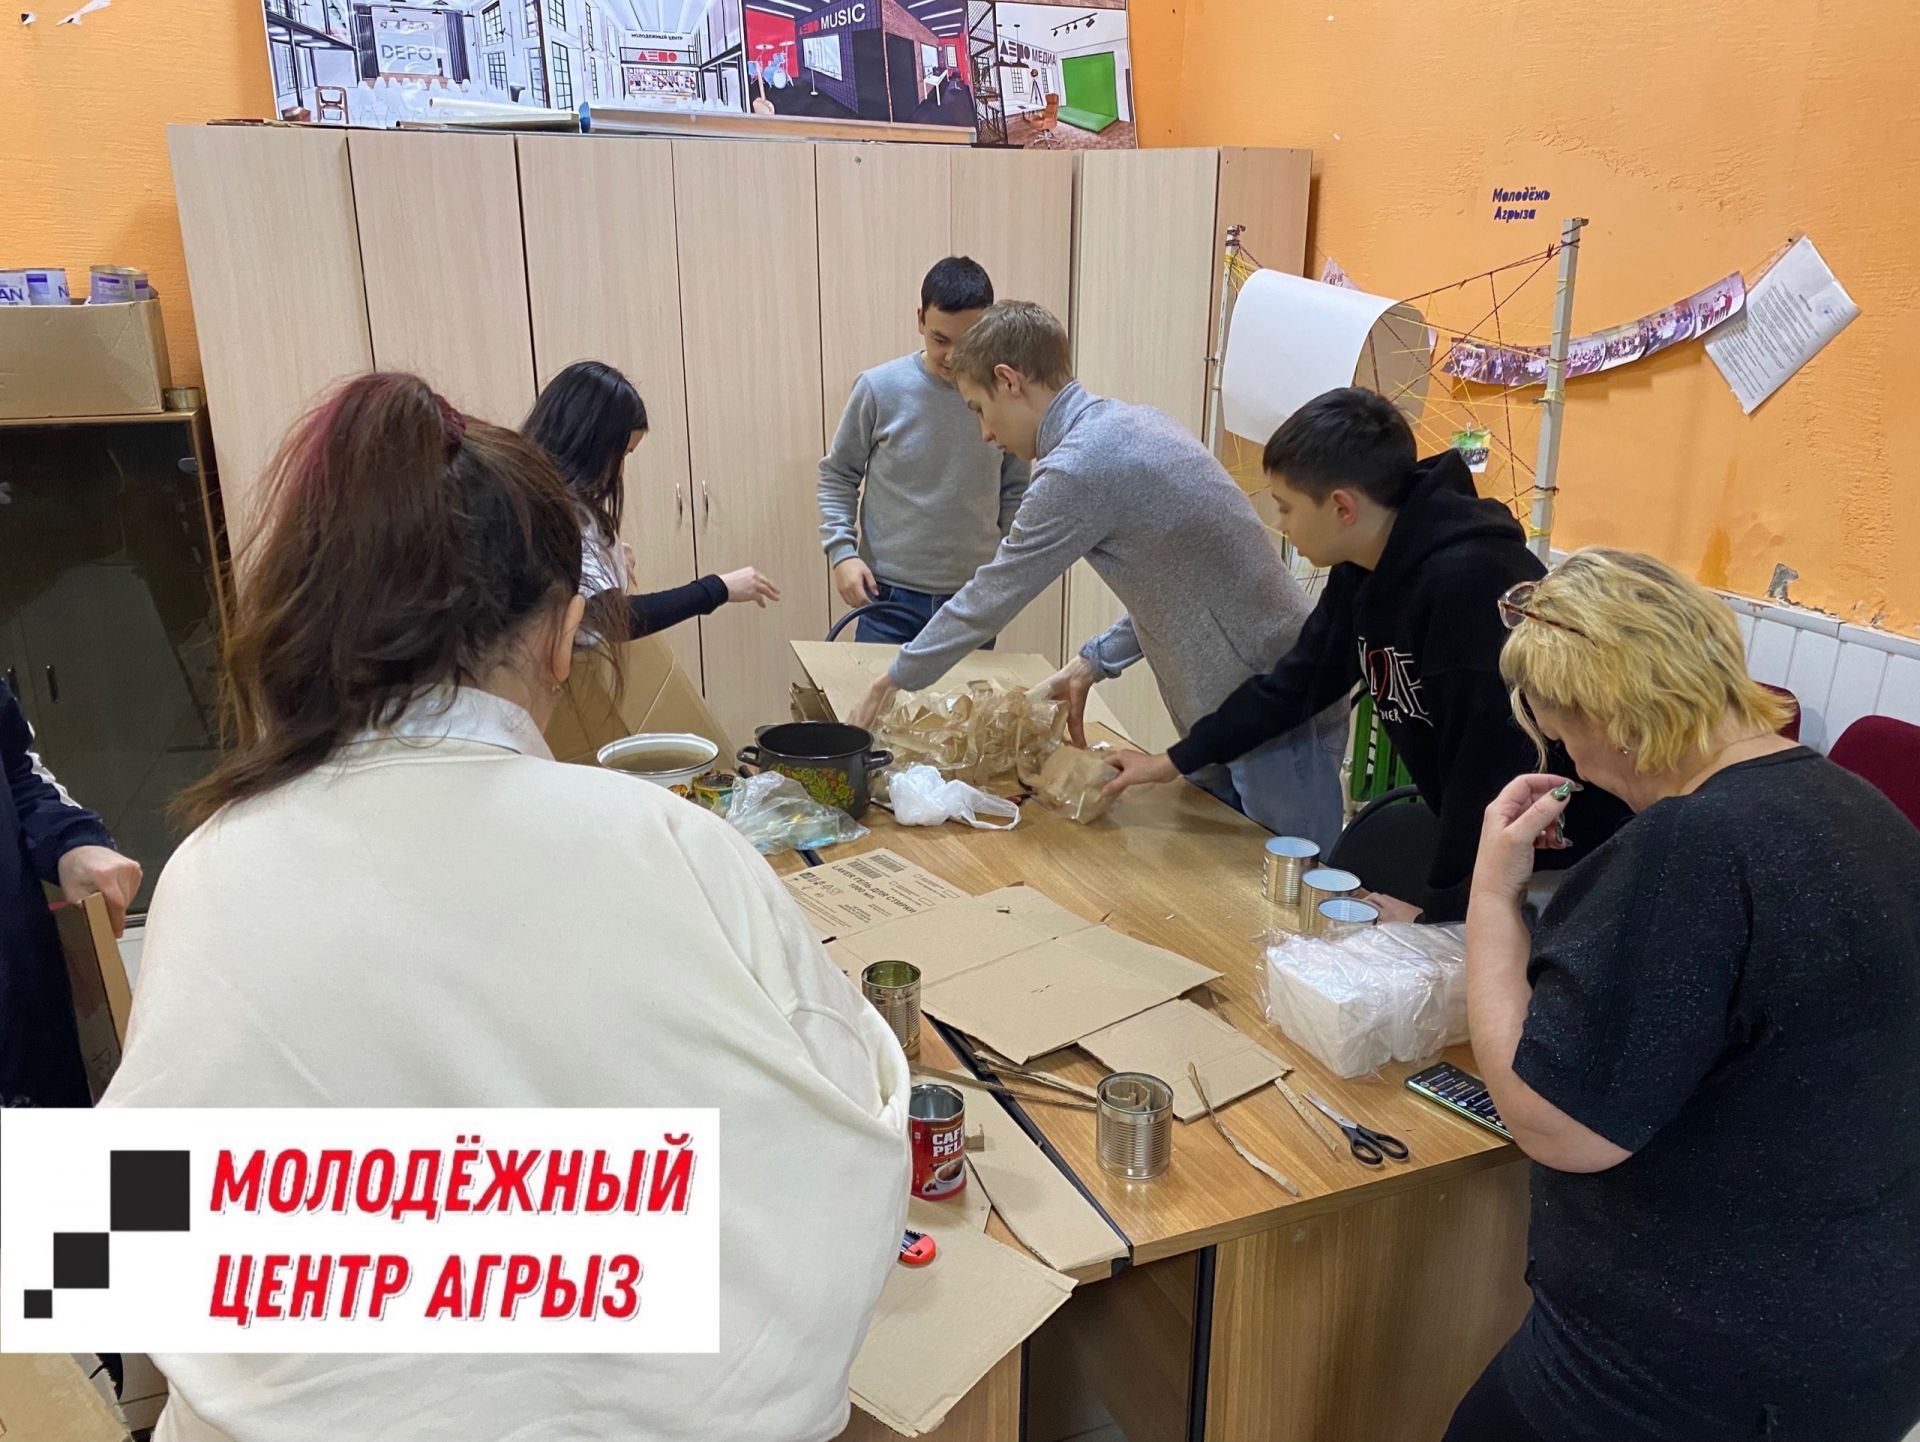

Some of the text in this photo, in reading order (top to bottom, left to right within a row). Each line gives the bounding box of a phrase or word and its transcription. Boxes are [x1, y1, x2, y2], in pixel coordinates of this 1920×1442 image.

[820, 3, 866, 31] MUSIC
[381, 44, 433, 61] DEPO
[1031, 48, 1057, 67] МЕДИА
[1492, 186, 1551, 203] Молодёжь
[1494, 206, 1537, 224] Агрыза
